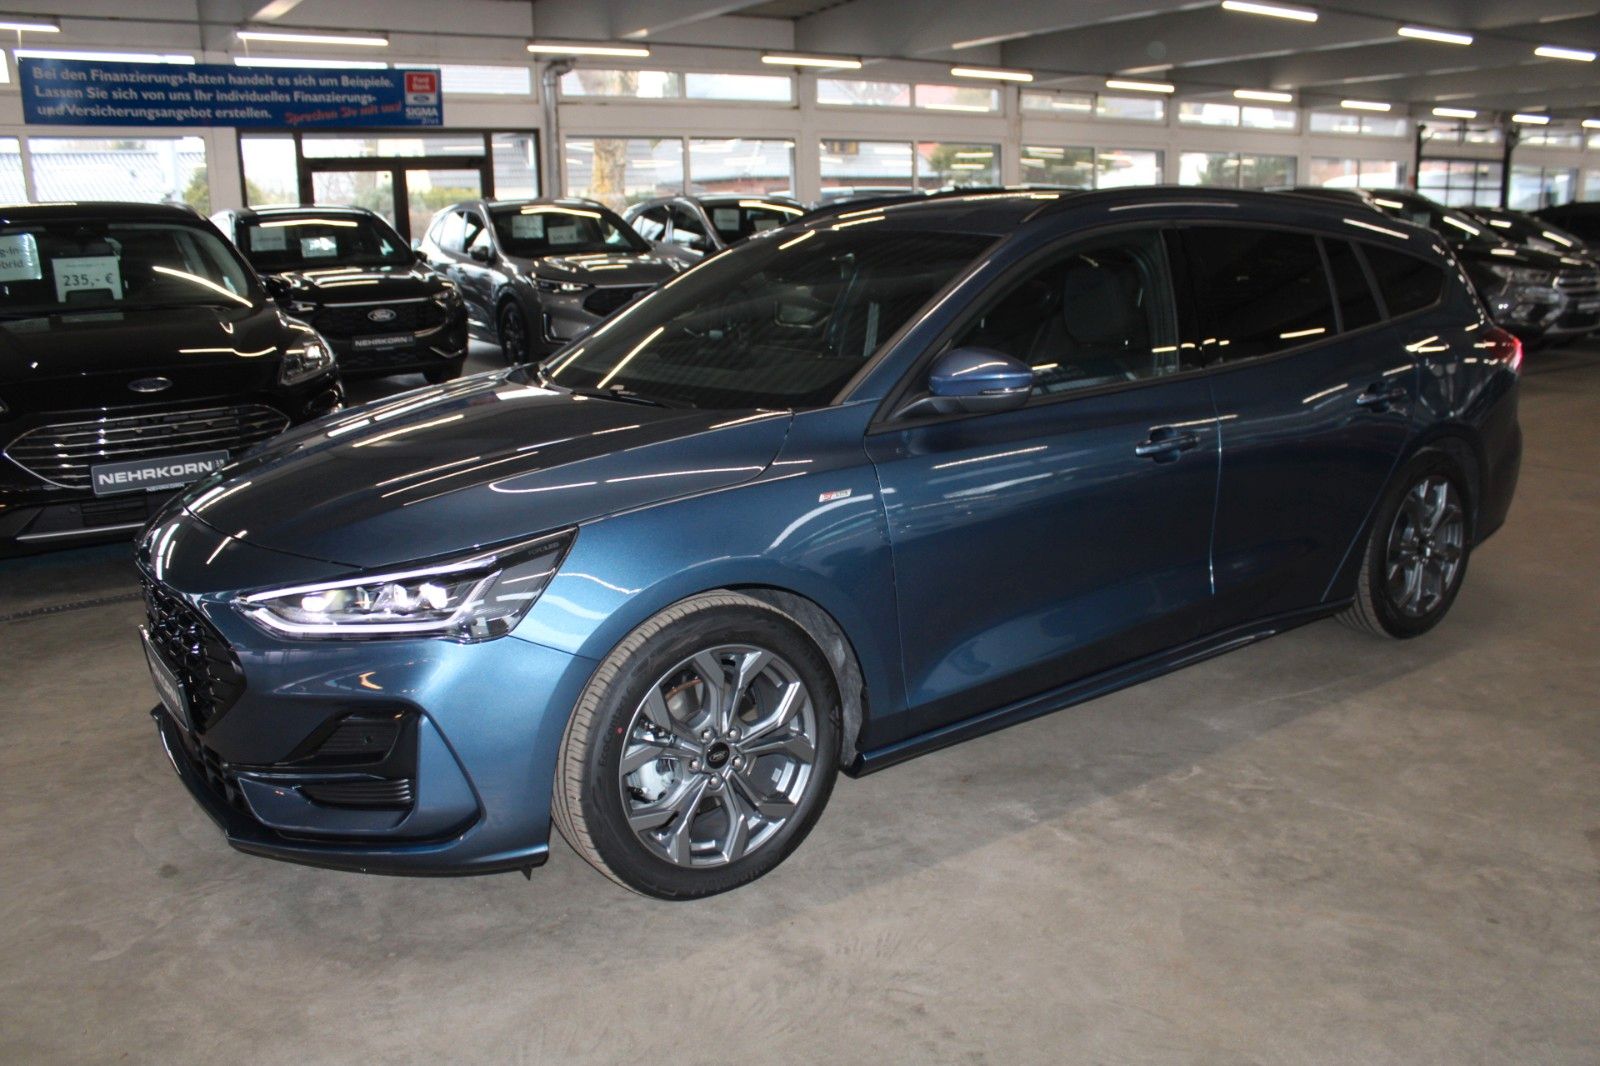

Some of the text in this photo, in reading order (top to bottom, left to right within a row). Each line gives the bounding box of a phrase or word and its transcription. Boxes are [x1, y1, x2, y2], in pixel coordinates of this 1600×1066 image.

[32, 66, 394, 89] Bei den Finanzierungs-Raten handelt es sich um Beispiele.
[35, 85, 377, 105] Lassen Sie sich von uns Ihr individuelles Finanzierungs-
[215, 107, 272, 119] erstellen.
[98, 461, 213, 485] NEHRKORN
